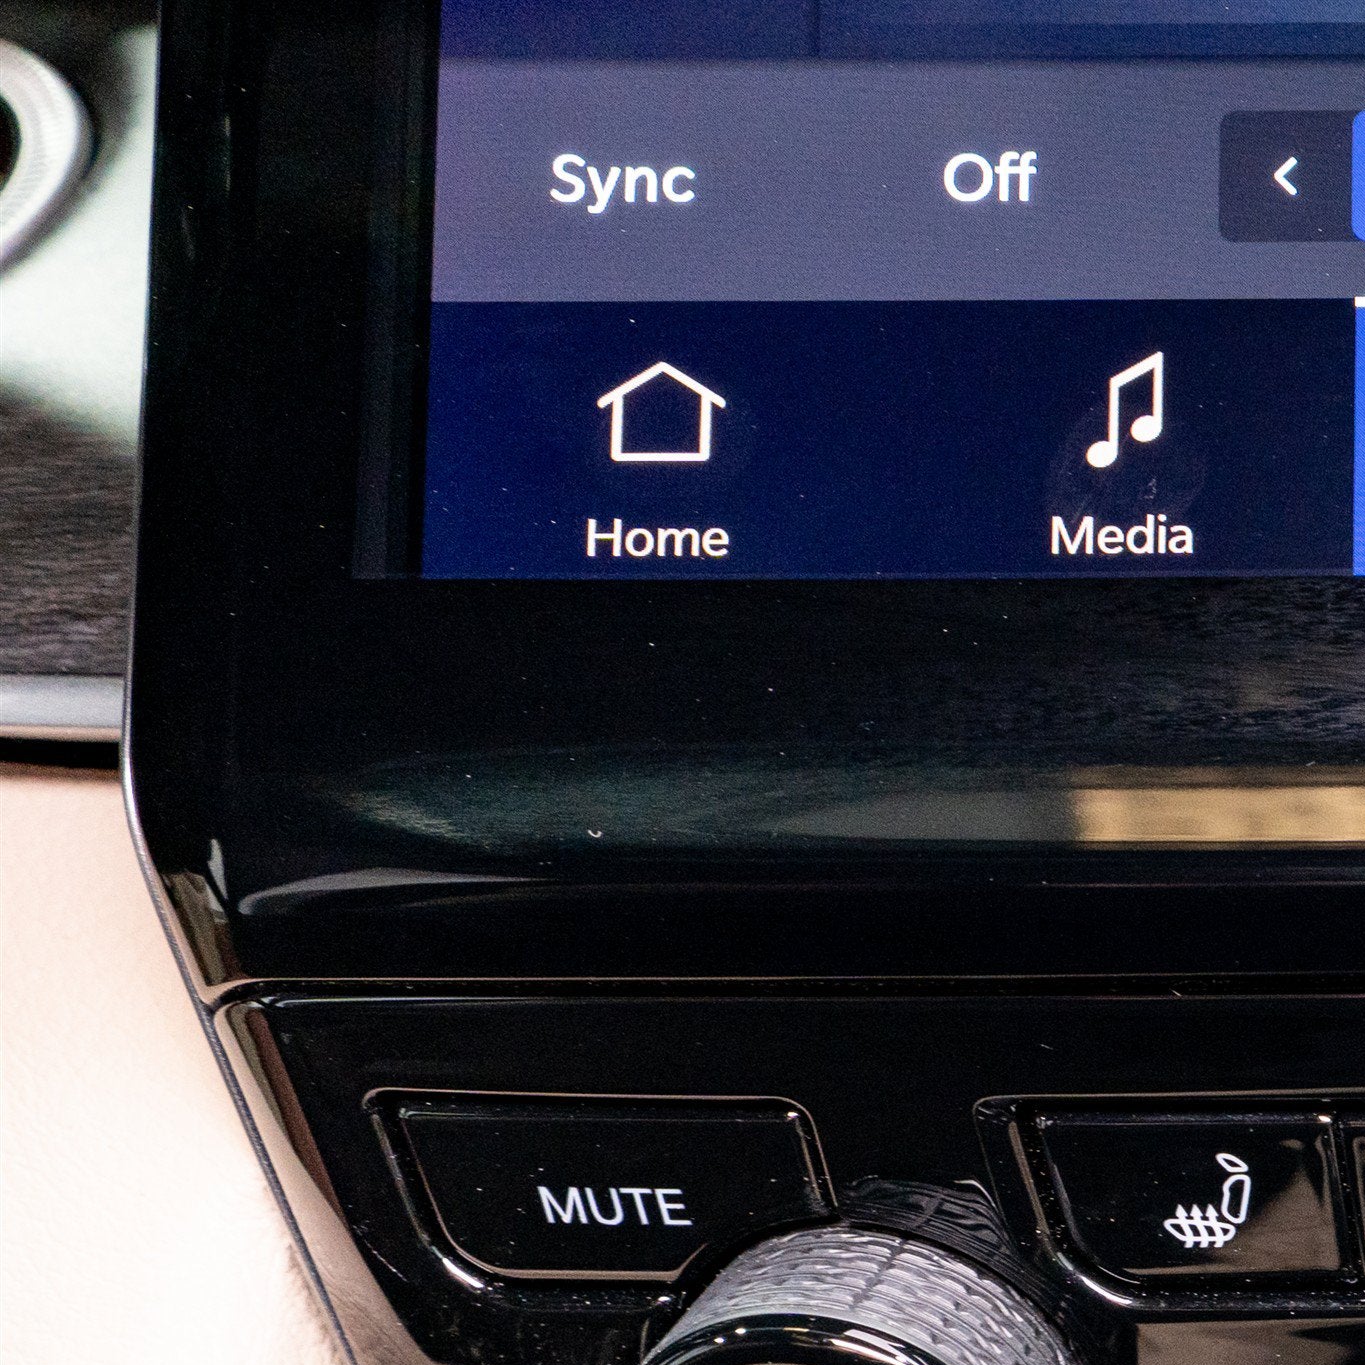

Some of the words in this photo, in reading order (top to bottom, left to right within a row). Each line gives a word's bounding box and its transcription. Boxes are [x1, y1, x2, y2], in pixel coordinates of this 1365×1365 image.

[550, 154, 695, 214] Sync
[944, 151, 1036, 202] Off
[587, 518, 729, 557] Home
[1052, 514, 1193, 554] Media
[538, 1186, 692, 1225] MUTE
